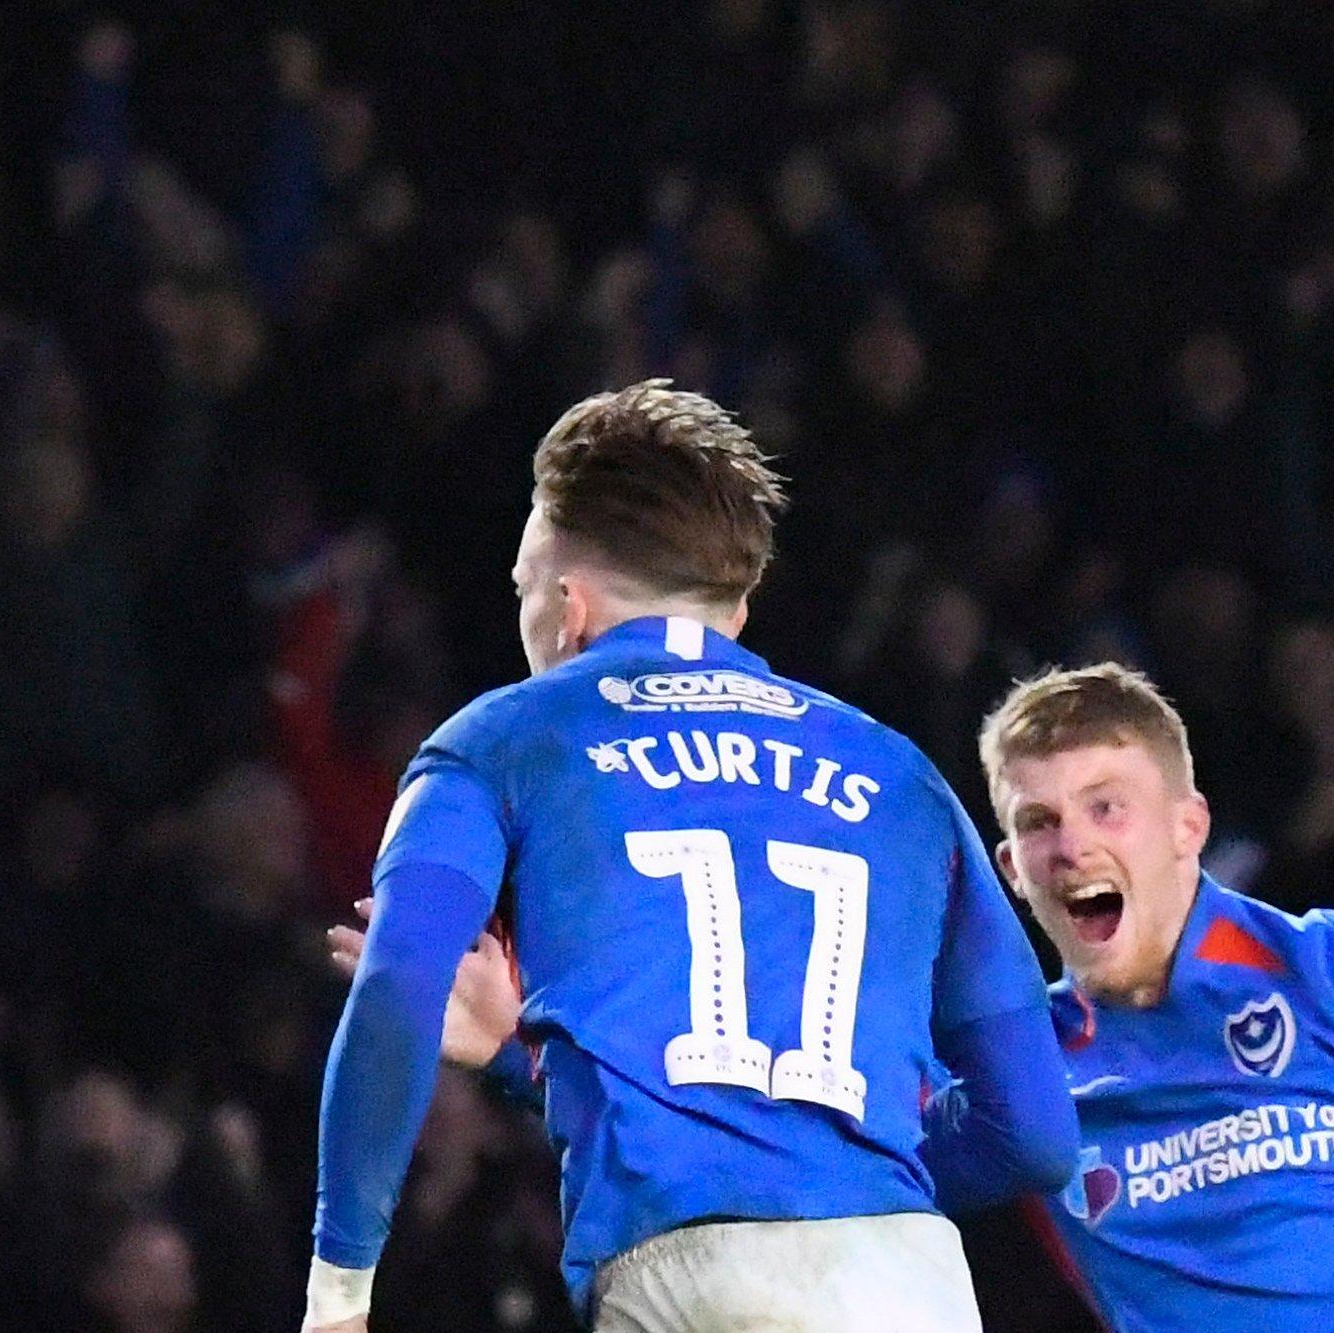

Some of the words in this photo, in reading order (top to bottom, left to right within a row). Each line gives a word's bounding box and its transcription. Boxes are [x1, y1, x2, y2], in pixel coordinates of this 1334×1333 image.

[644, 673, 796, 707] COVERS
[627, 730, 881, 823] CURTIS
[623, 828, 869, 1124] 11
[1123, 1103, 1321, 1175] UNIVERSITY
